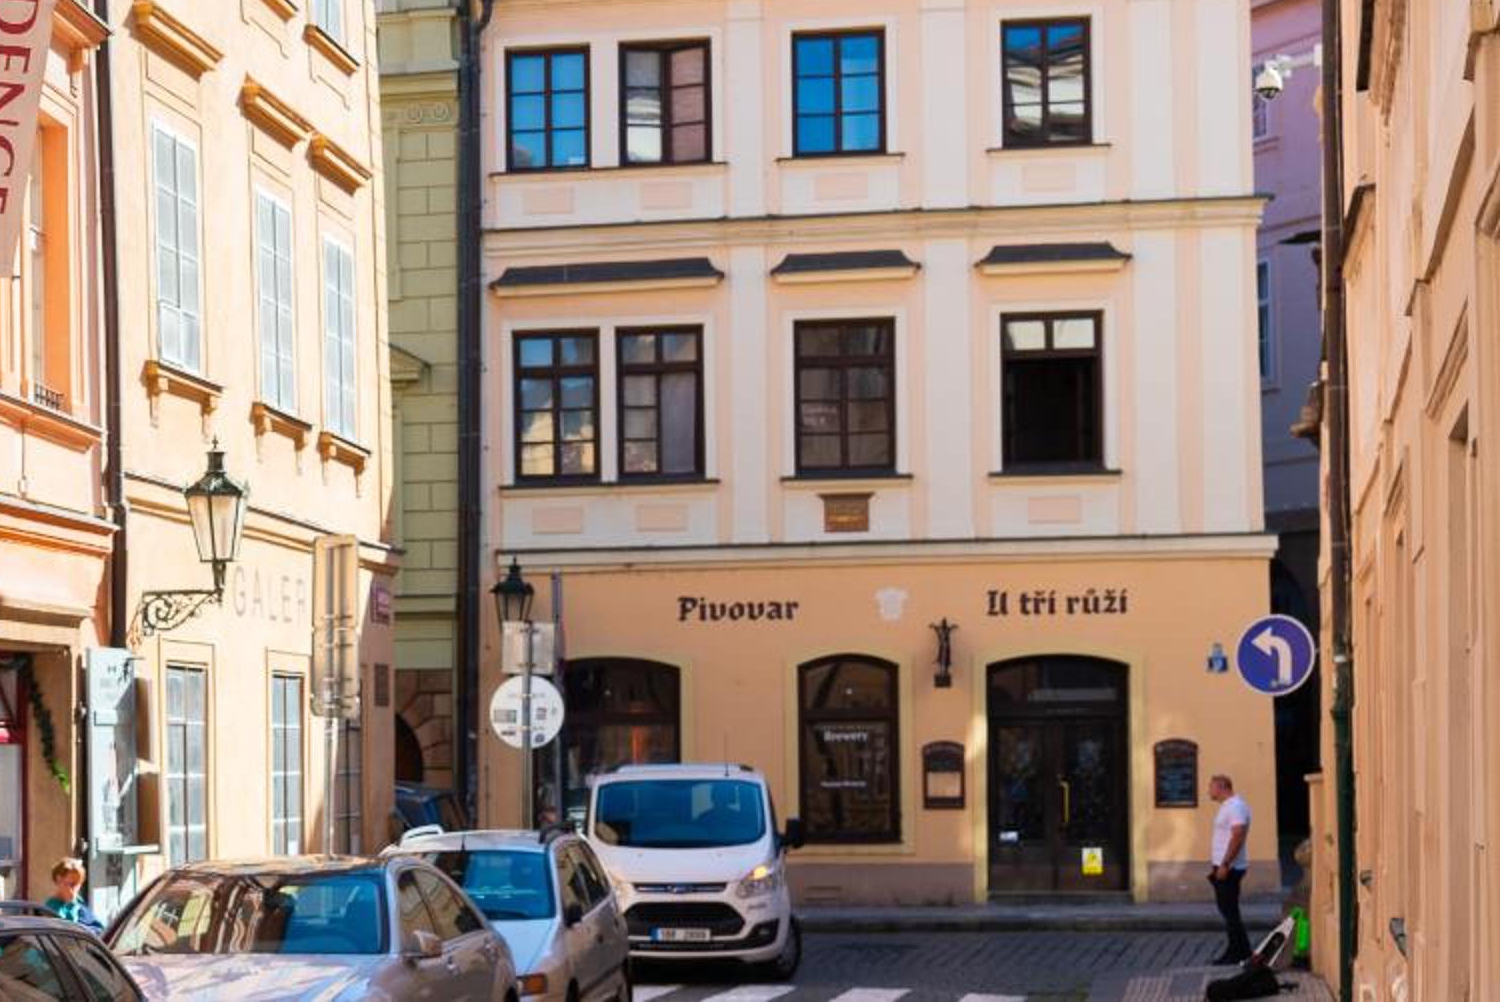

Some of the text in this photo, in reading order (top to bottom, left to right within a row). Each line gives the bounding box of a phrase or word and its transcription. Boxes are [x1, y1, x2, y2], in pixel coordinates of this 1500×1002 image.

[677, 596, 799, 621] Pivovar
[1020, 590, 1056, 615] tří
[1065, 588, 1128, 615] růží
